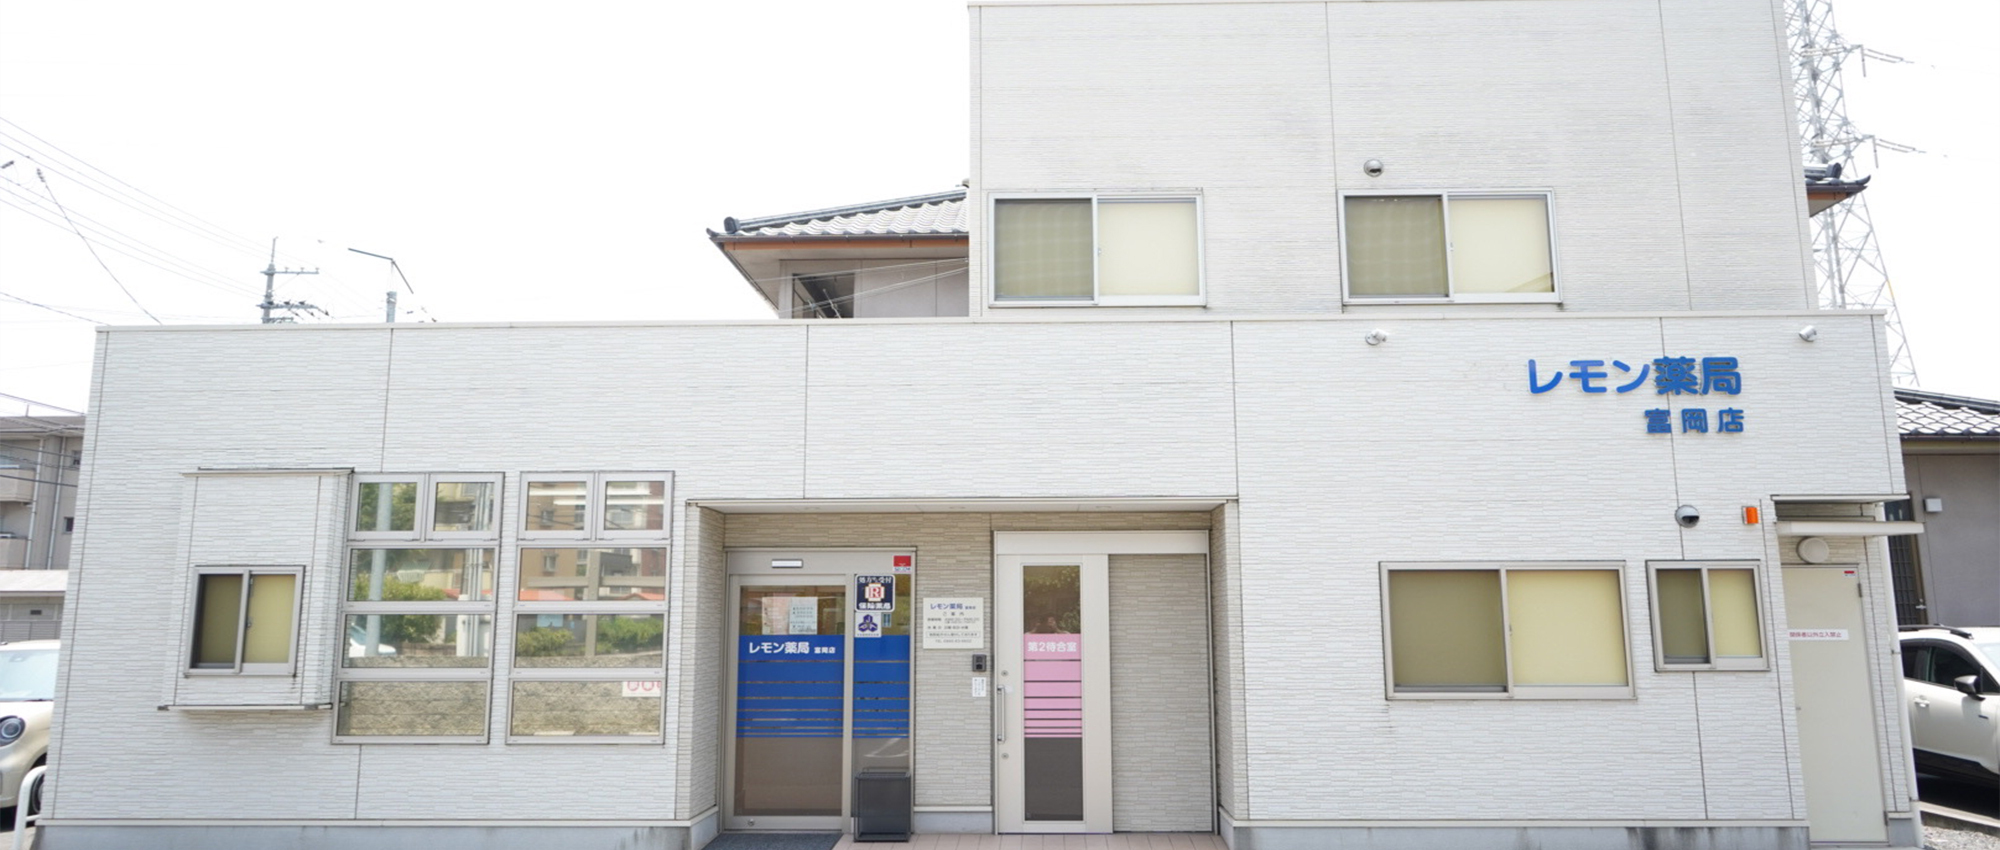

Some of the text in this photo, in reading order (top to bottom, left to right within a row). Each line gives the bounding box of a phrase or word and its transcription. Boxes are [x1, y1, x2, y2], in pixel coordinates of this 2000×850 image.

[1528, 356, 1742, 396] レモン薬局
[1644, 407, 1744, 434] 富岡店
[749, 641, 810, 654] レモン薬局
[1027, 641, 1077, 652] 第2待合室
